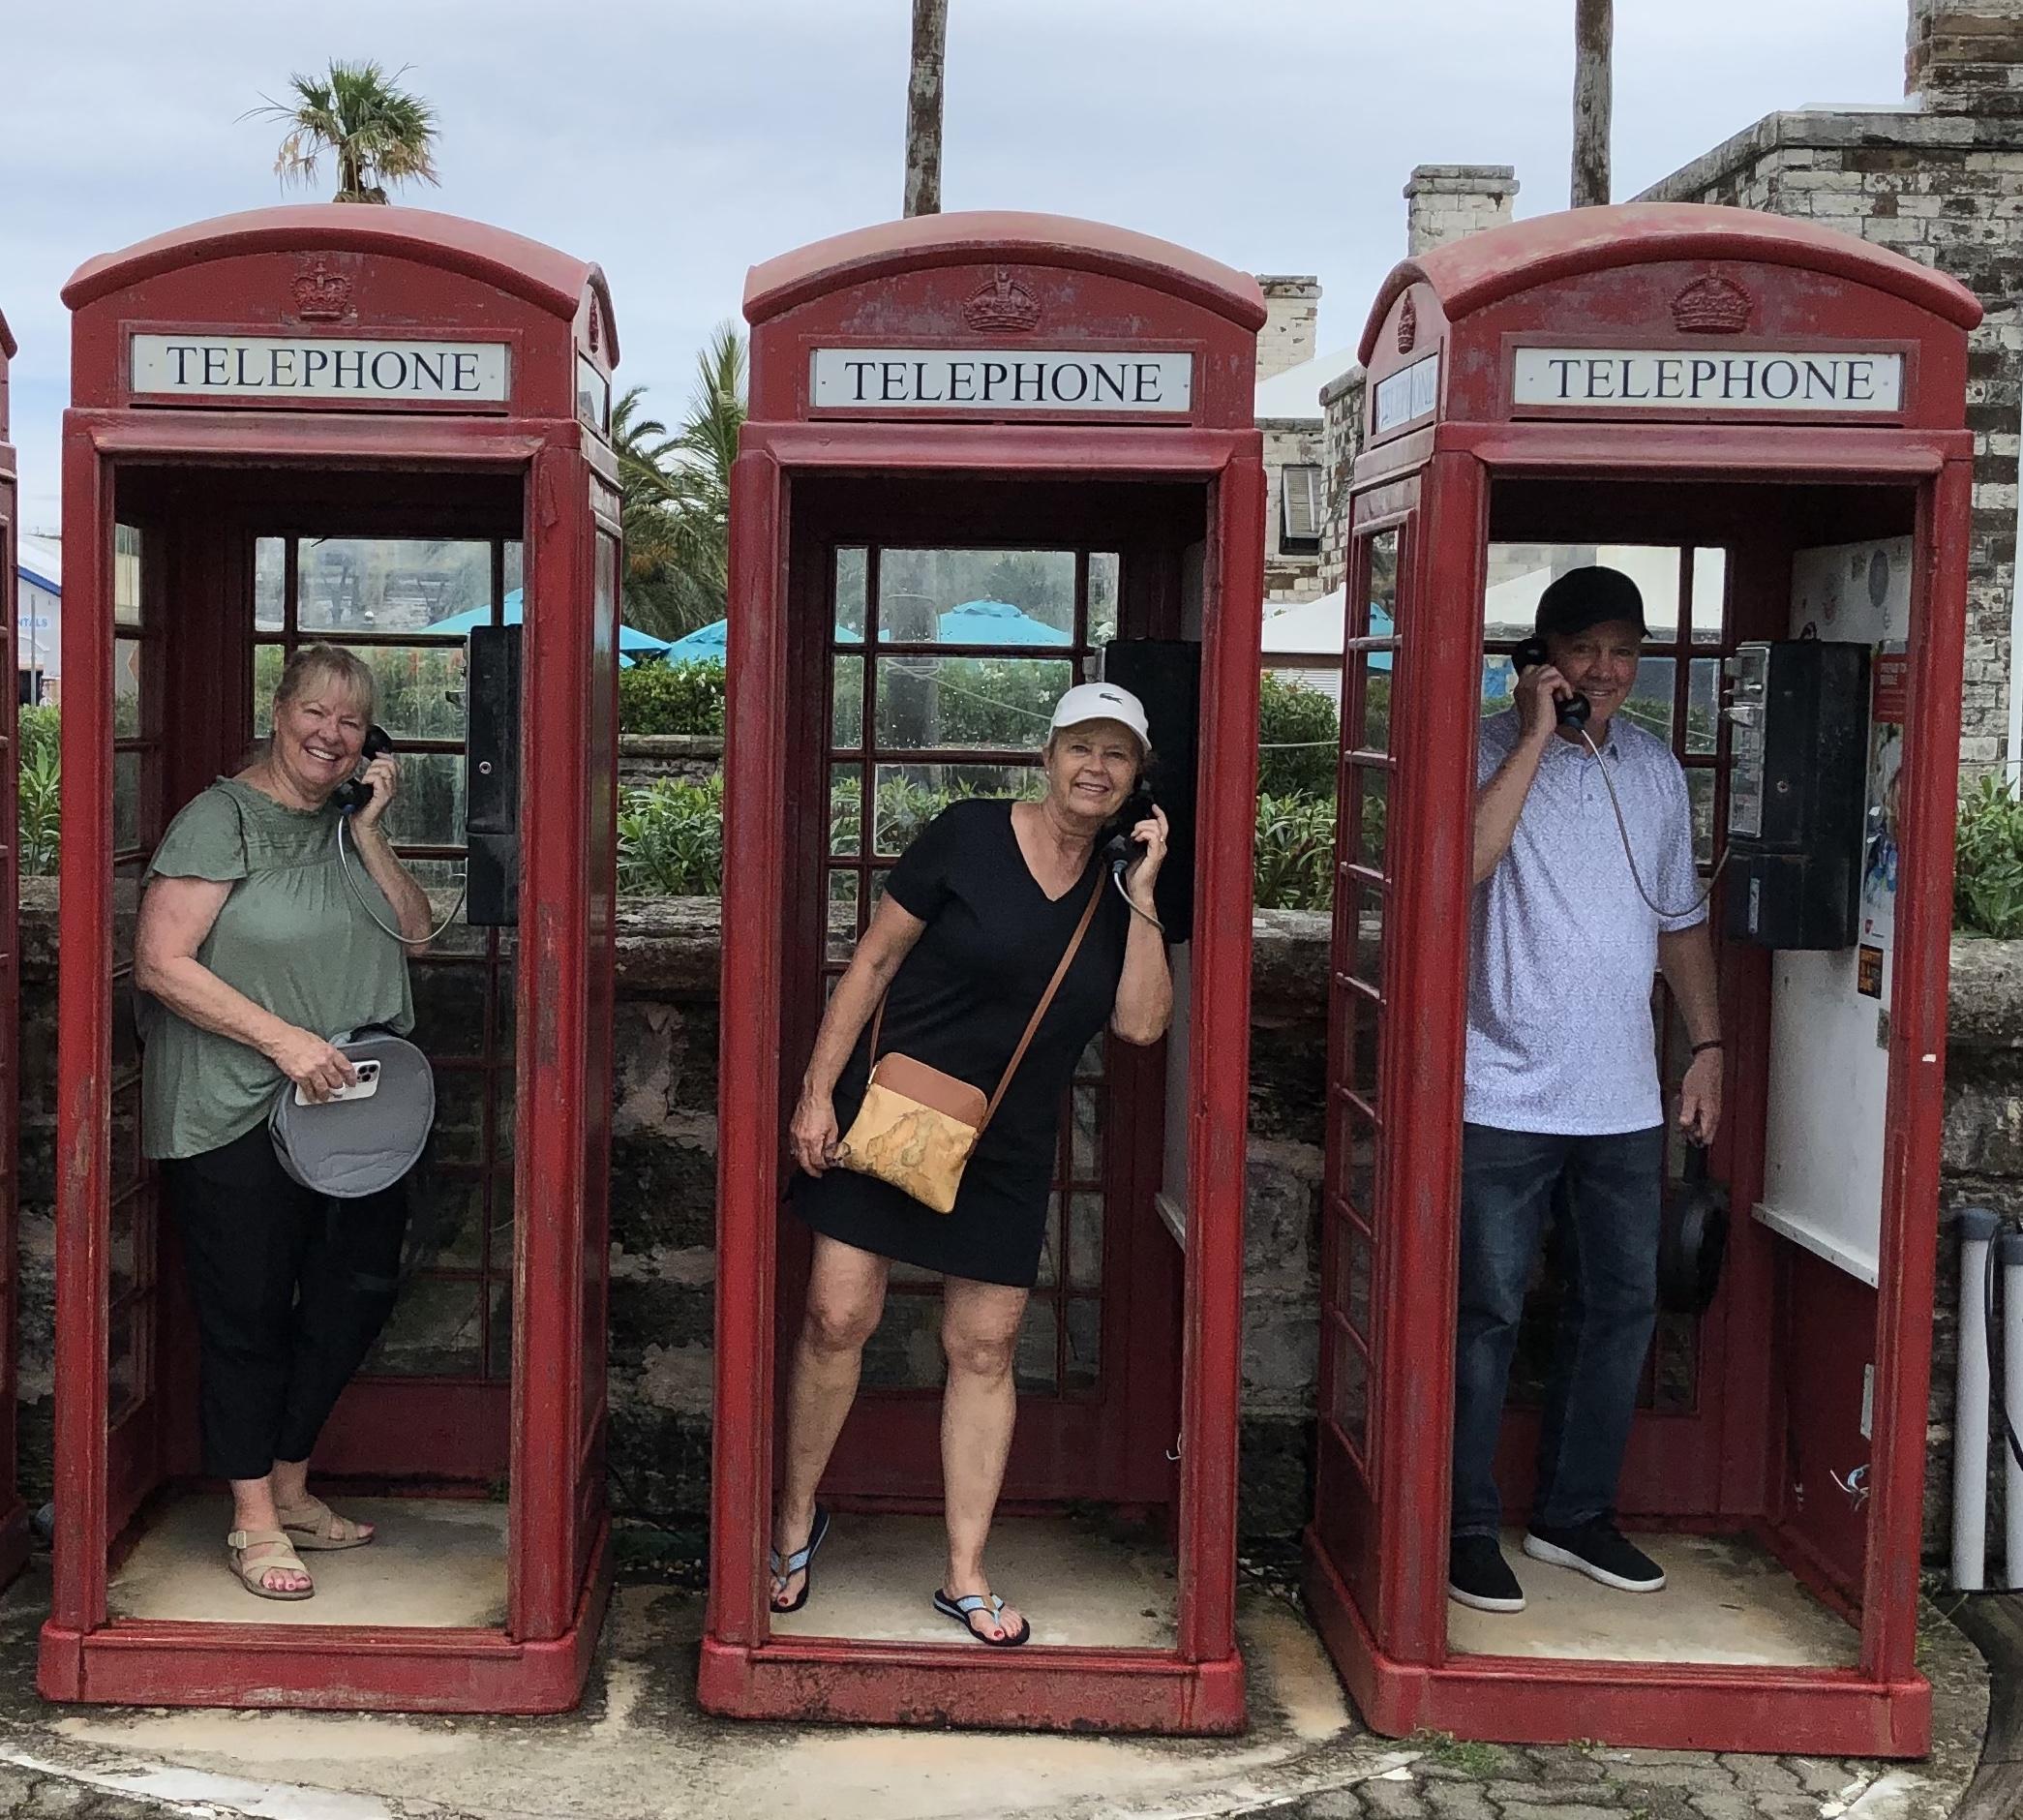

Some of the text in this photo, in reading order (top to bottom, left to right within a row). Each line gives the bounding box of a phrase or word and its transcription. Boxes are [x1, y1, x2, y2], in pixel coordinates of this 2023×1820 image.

[166, 347, 481, 392] TELEPHONE
[845, 363, 1162, 402] TELEPHONE
[1549, 360, 1875, 399] TELEPHONE
